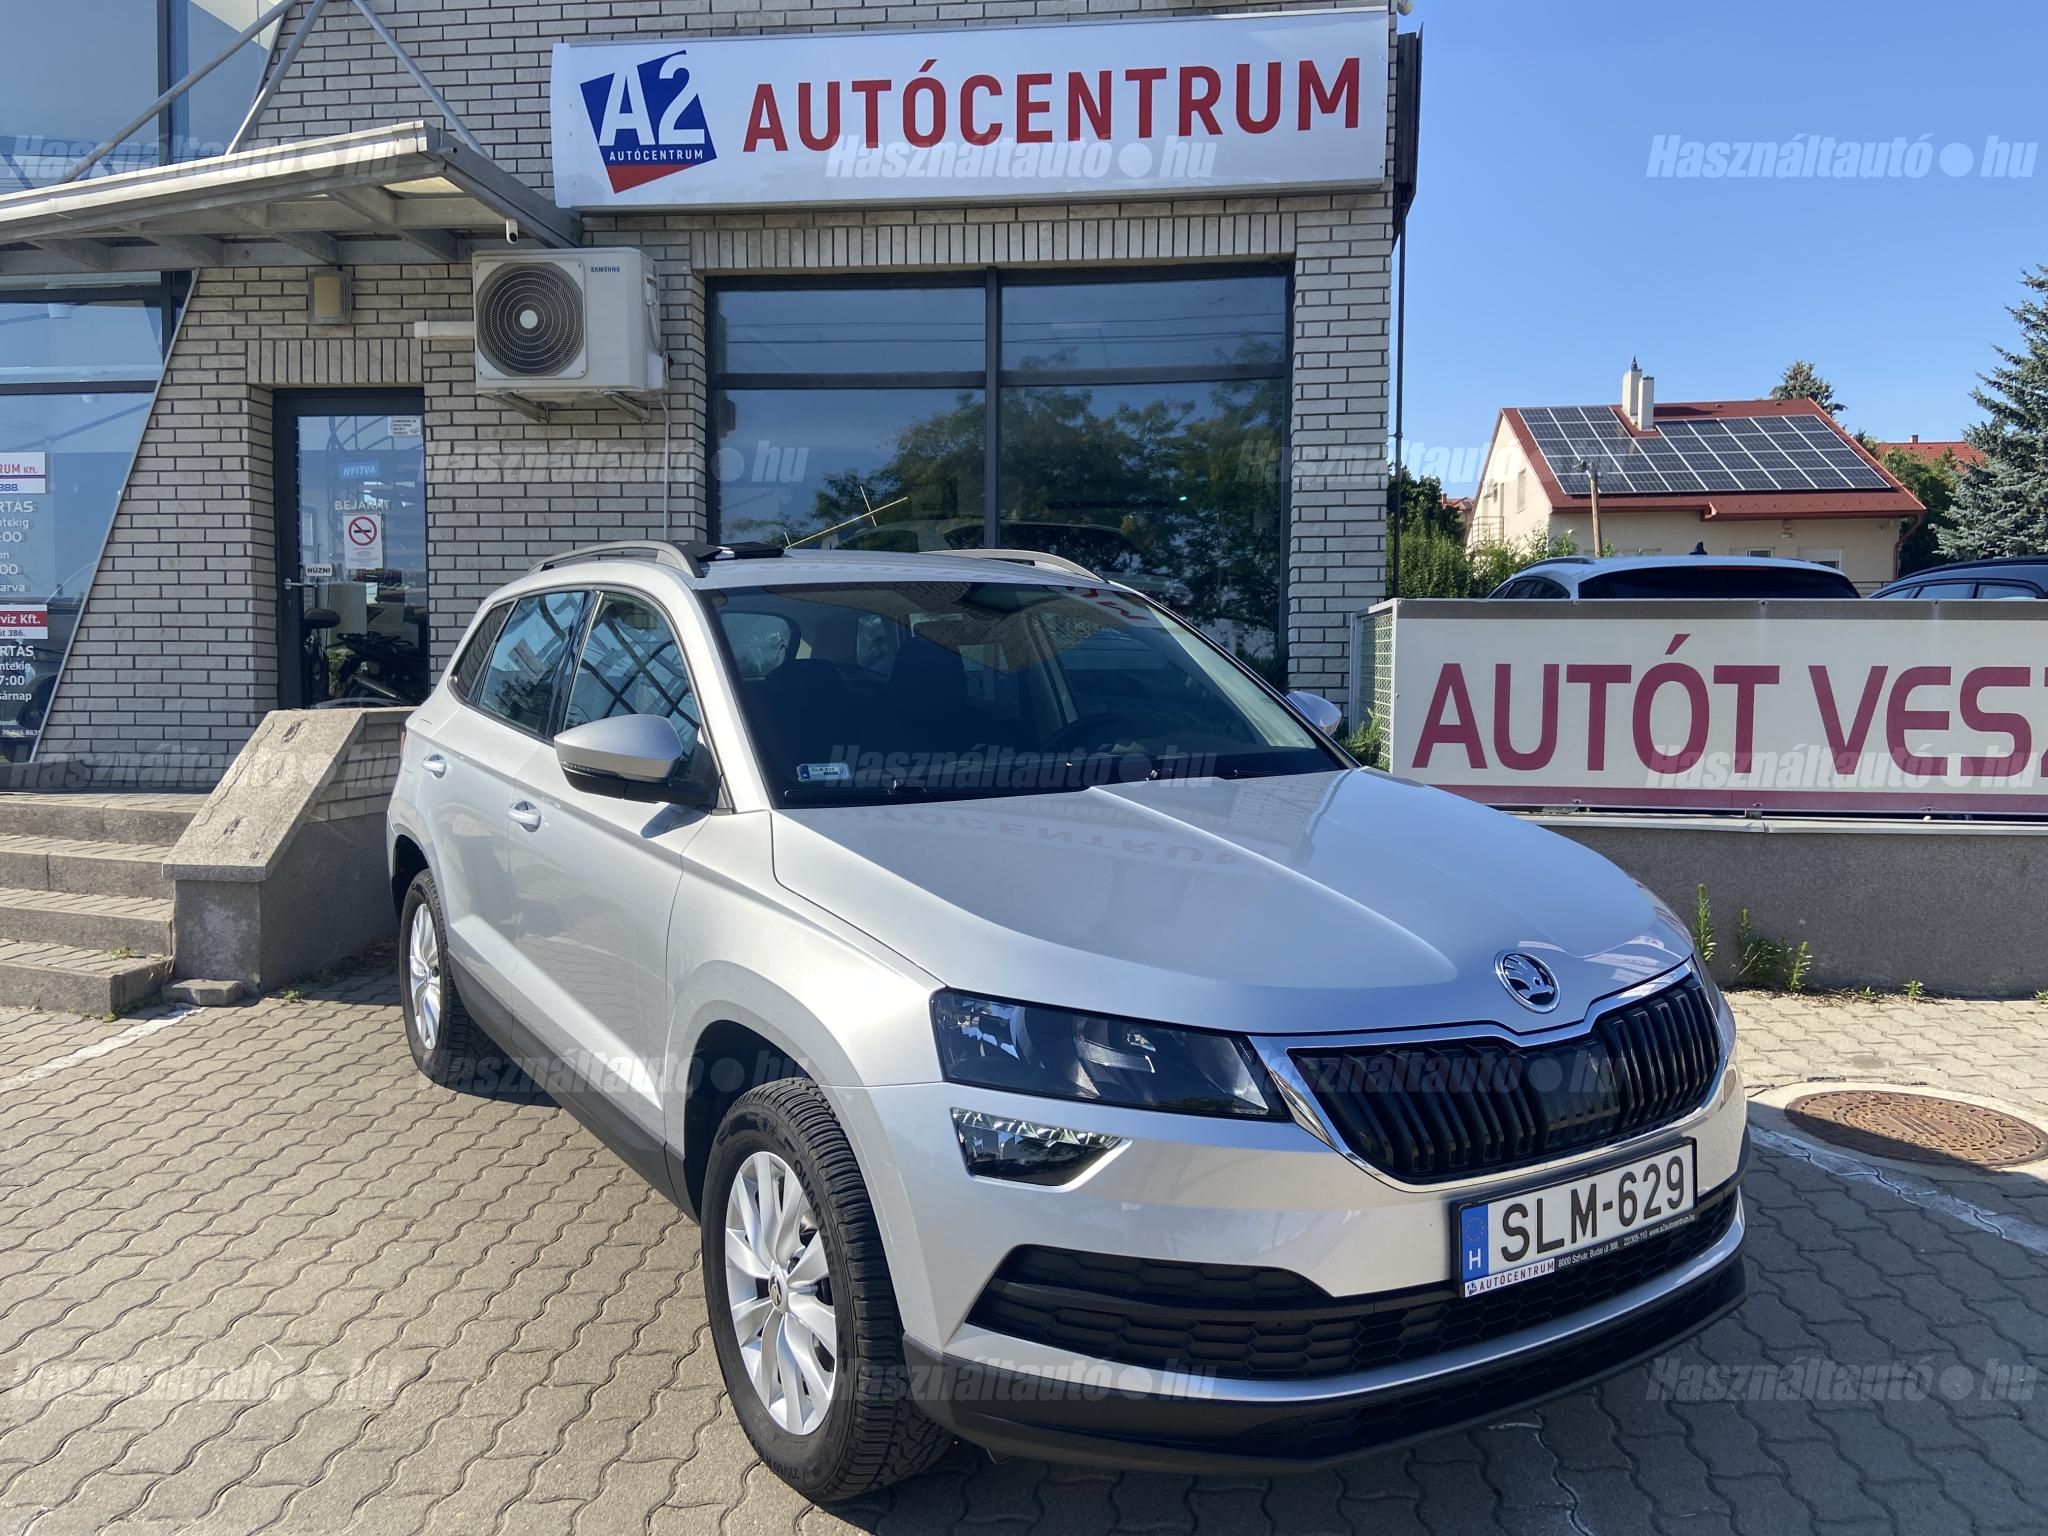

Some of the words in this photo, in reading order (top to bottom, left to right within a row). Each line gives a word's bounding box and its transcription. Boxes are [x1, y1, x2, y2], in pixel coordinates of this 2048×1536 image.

[599, 53, 705, 146] A2
[743, 57, 1360, 153] AUTÓCENTRUM
[609, 148, 703, 161] AUTÓCENTRUM
[343, 464, 376, 477] NYITVA
[20, 614, 41, 624] Kft.
[0, 690, 32, 702] árnap
[1411, 633, 1781, 776] AUTÓT
[1501, 1155, 1685, 1262] SLM-629
[1469, 1248, 1481, 1271] H
[1480, 1261, 1555, 1292] AUTÓCENTRUM
